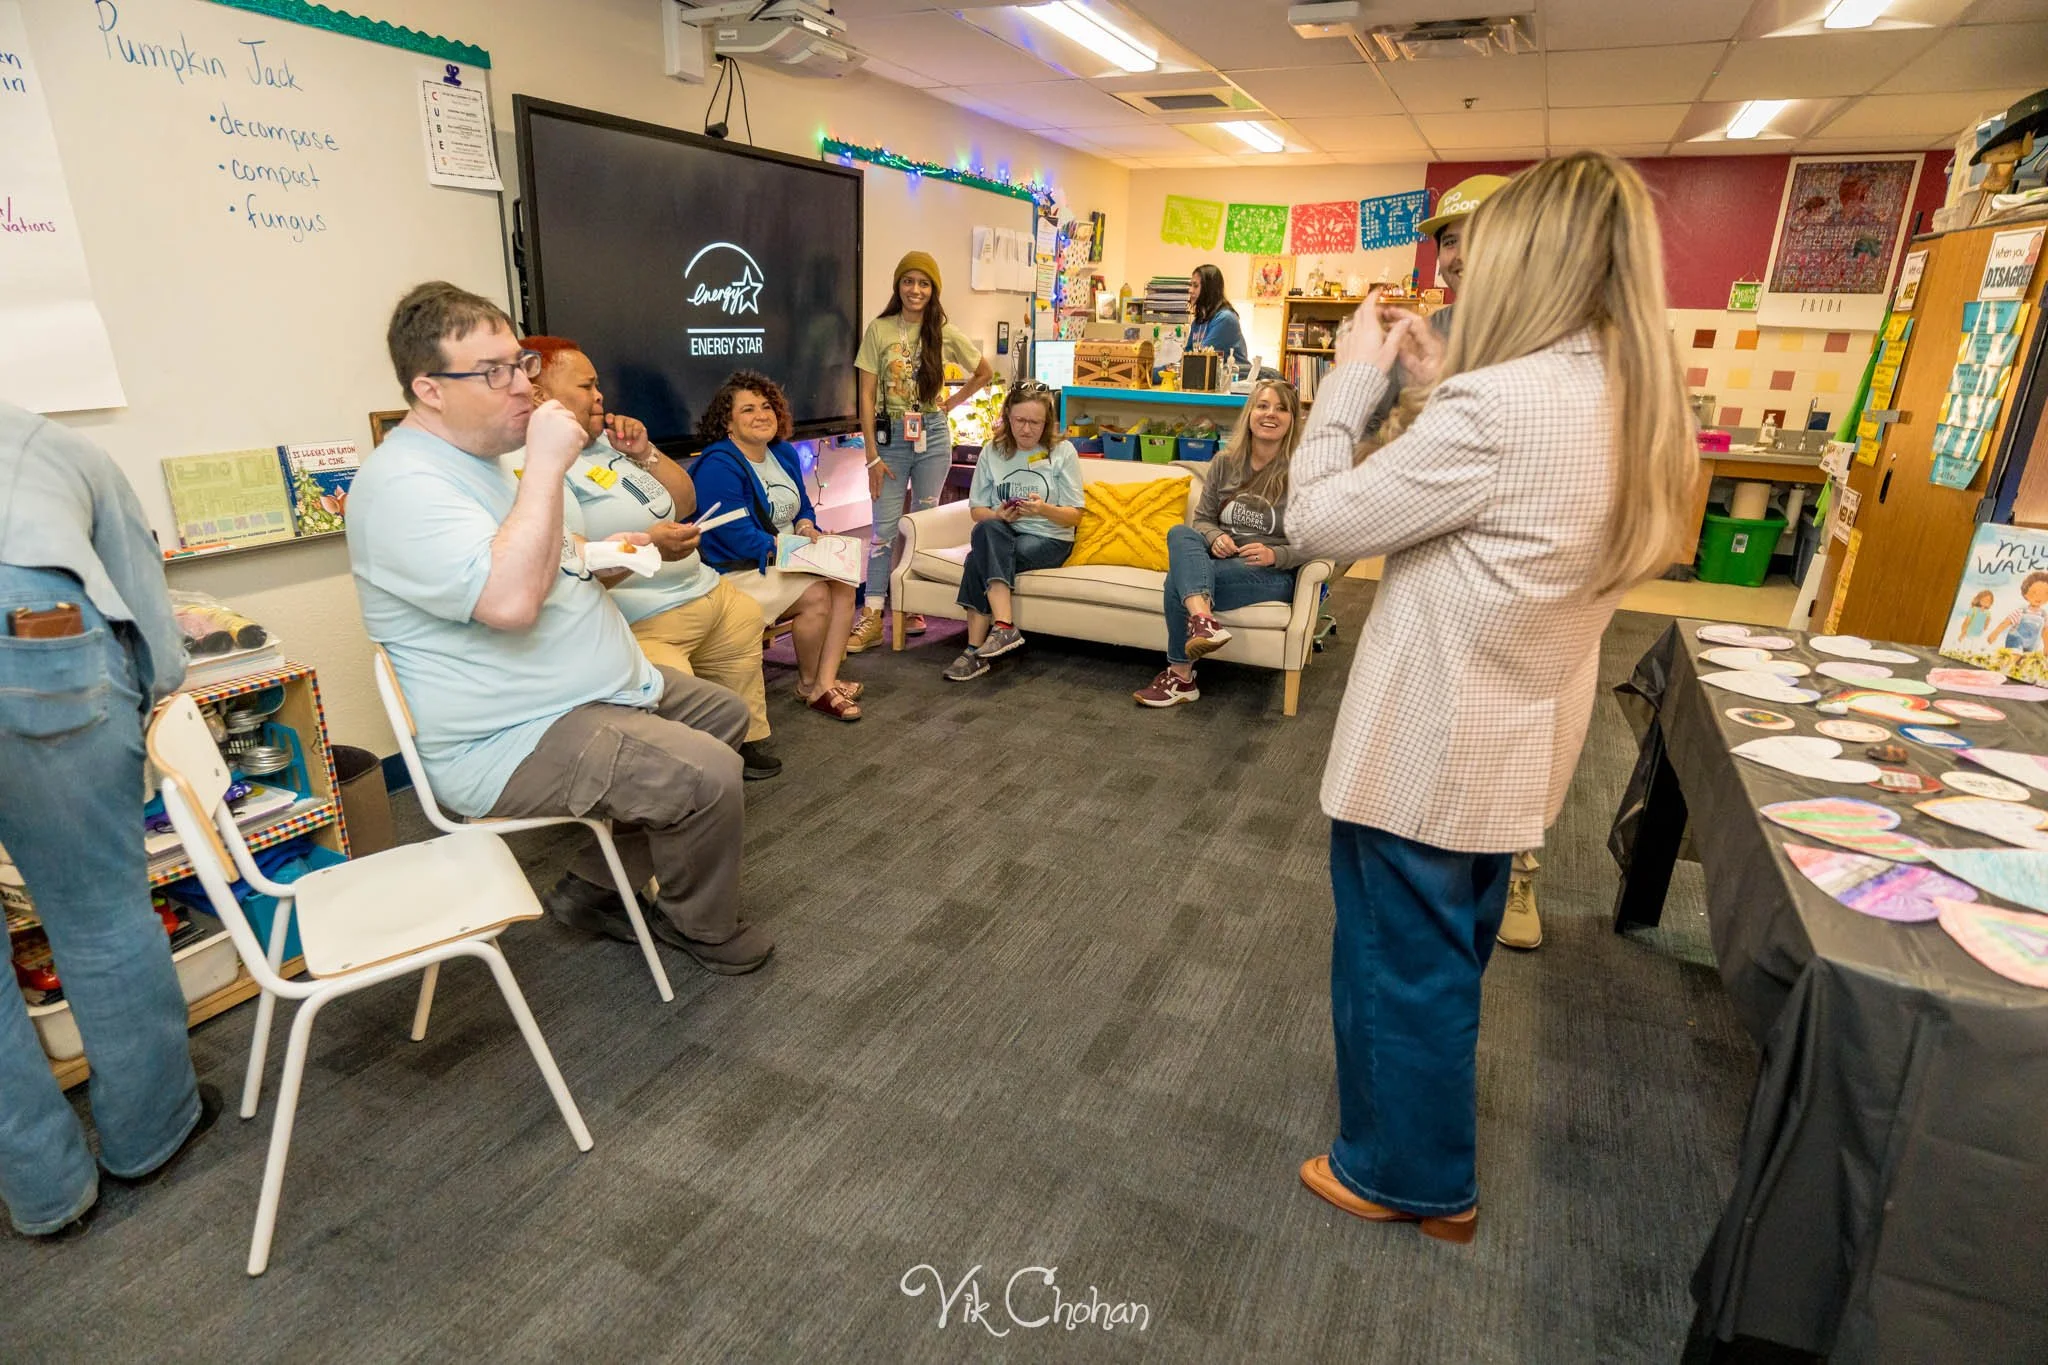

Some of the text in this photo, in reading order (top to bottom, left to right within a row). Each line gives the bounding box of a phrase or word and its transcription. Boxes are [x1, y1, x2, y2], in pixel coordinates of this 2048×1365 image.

[96, 0, 303, 91] Pumpkin Jack
[220, 102, 340, 151] decompose
[232, 158, 320, 192] compost
[246, 193, 328, 243] fungus
[687, 283, 749, 315] energy
[1800, 298, 1843, 313] FRIDA
[691, 337, 764, 356] ENERGY STAR
[1977, 556, 2048, 576] WALK
